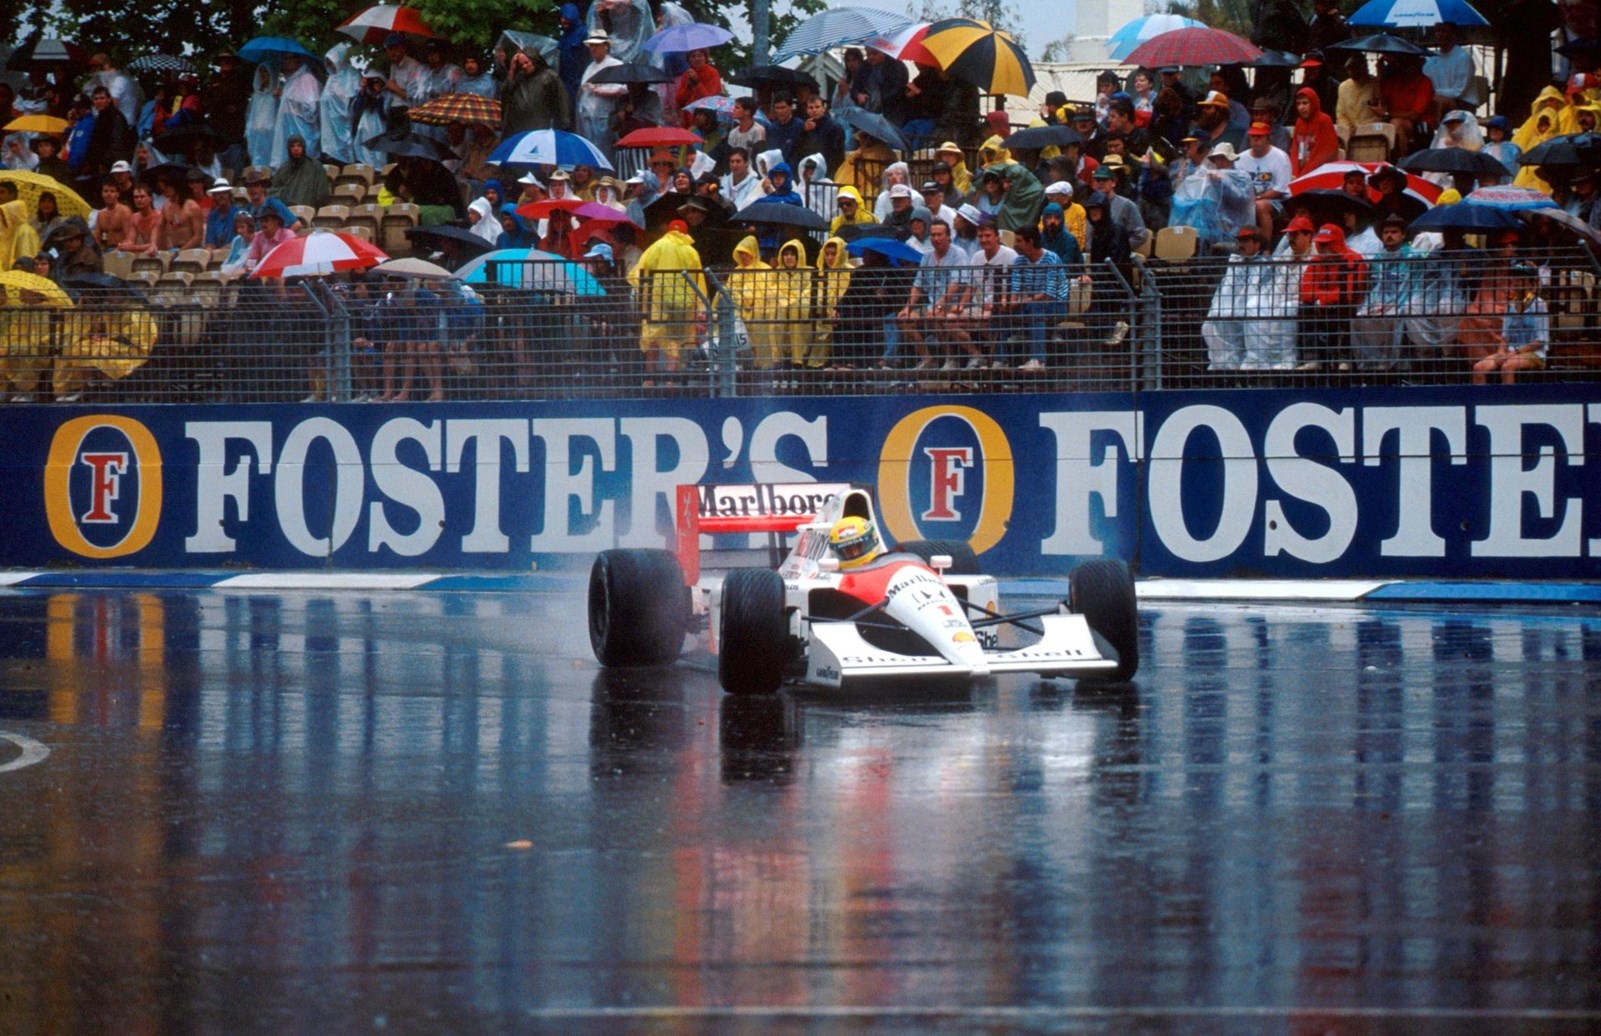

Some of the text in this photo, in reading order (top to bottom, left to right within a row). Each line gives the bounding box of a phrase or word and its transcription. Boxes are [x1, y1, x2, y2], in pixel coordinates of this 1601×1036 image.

[184, 411, 829, 557] FOSTER'S
[1038, 401, 1601, 564] FOSTE
[975, 630, 999, 649] She
